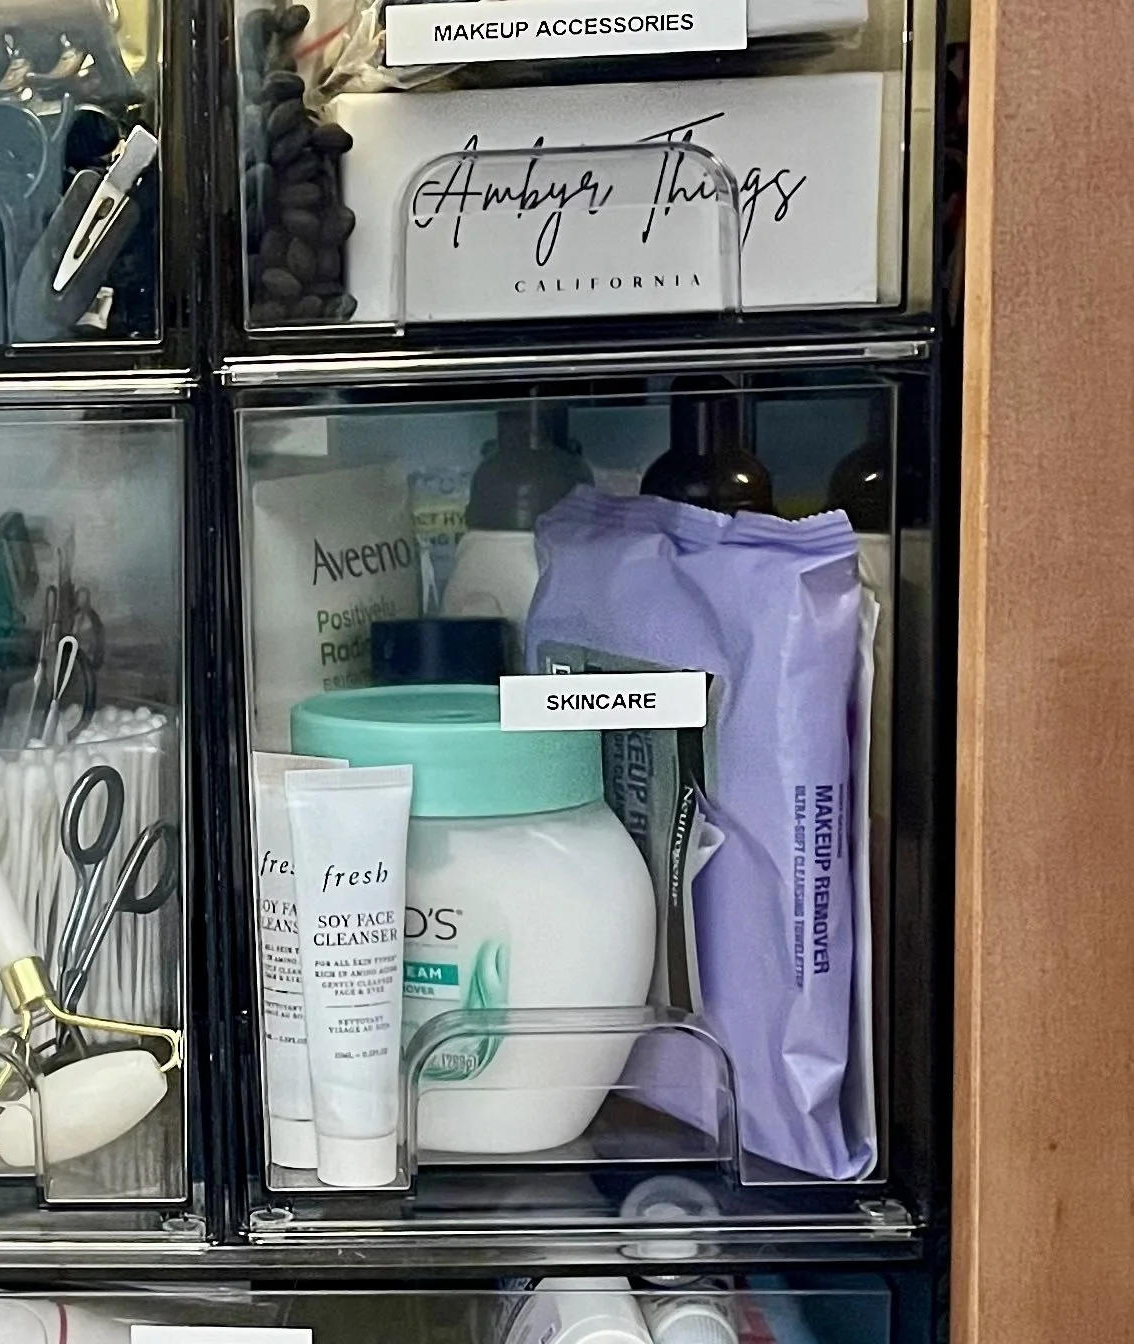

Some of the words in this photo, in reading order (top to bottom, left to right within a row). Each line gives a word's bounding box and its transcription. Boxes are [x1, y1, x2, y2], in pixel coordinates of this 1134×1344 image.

[434, 21, 529, 42] MAKEUP
[535, 13, 694, 38] ACCESSORIES
[413, 135, 614, 266] Ambyr
[637, 112, 807, 251] Things
[514, 273, 702, 294] CALIFORNIA
[313, 538, 411, 585] Aveeno
[547, 693, 657, 711] SKINCARE
[794, 785, 806, 853] ULTRA-SOFT
[814, 785, 833, 871] MAKEUP
[322, 861, 389, 893] fresh
[318, 914, 352, 929] SOY
[357, 910, 396, 928] FACE
[813, 876, 830, 974] REMOVER
[313, 927, 398, 947] CLEANSER
